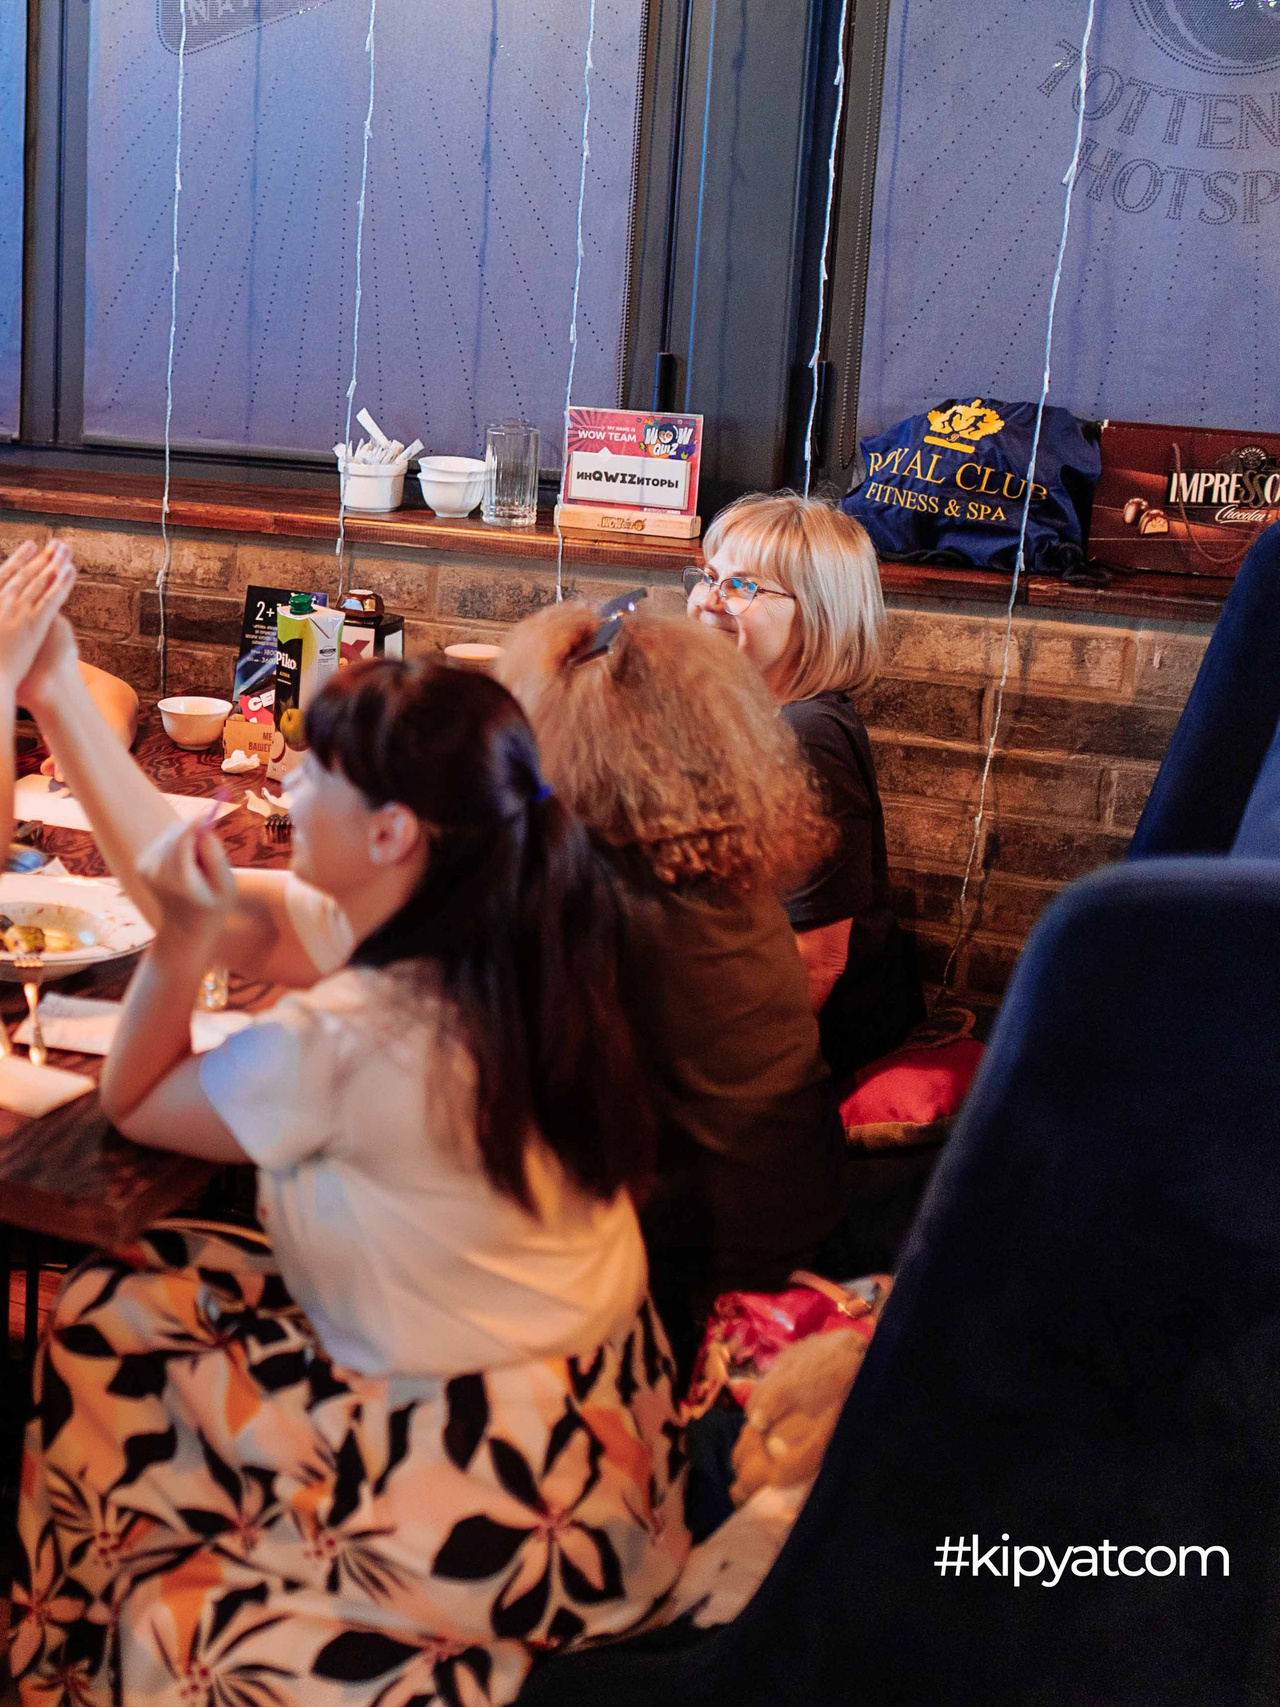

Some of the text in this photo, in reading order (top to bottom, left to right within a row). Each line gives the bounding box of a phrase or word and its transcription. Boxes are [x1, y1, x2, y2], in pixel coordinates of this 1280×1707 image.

[578, 430, 637, 442] WOW TEAM
[653, 443, 679, 456] QUIZ
[956, 462, 1048, 501] CLUB
[865, 482, 1006, 521] FITNESS & SPA
[276, 651, 297, 670] Piko
